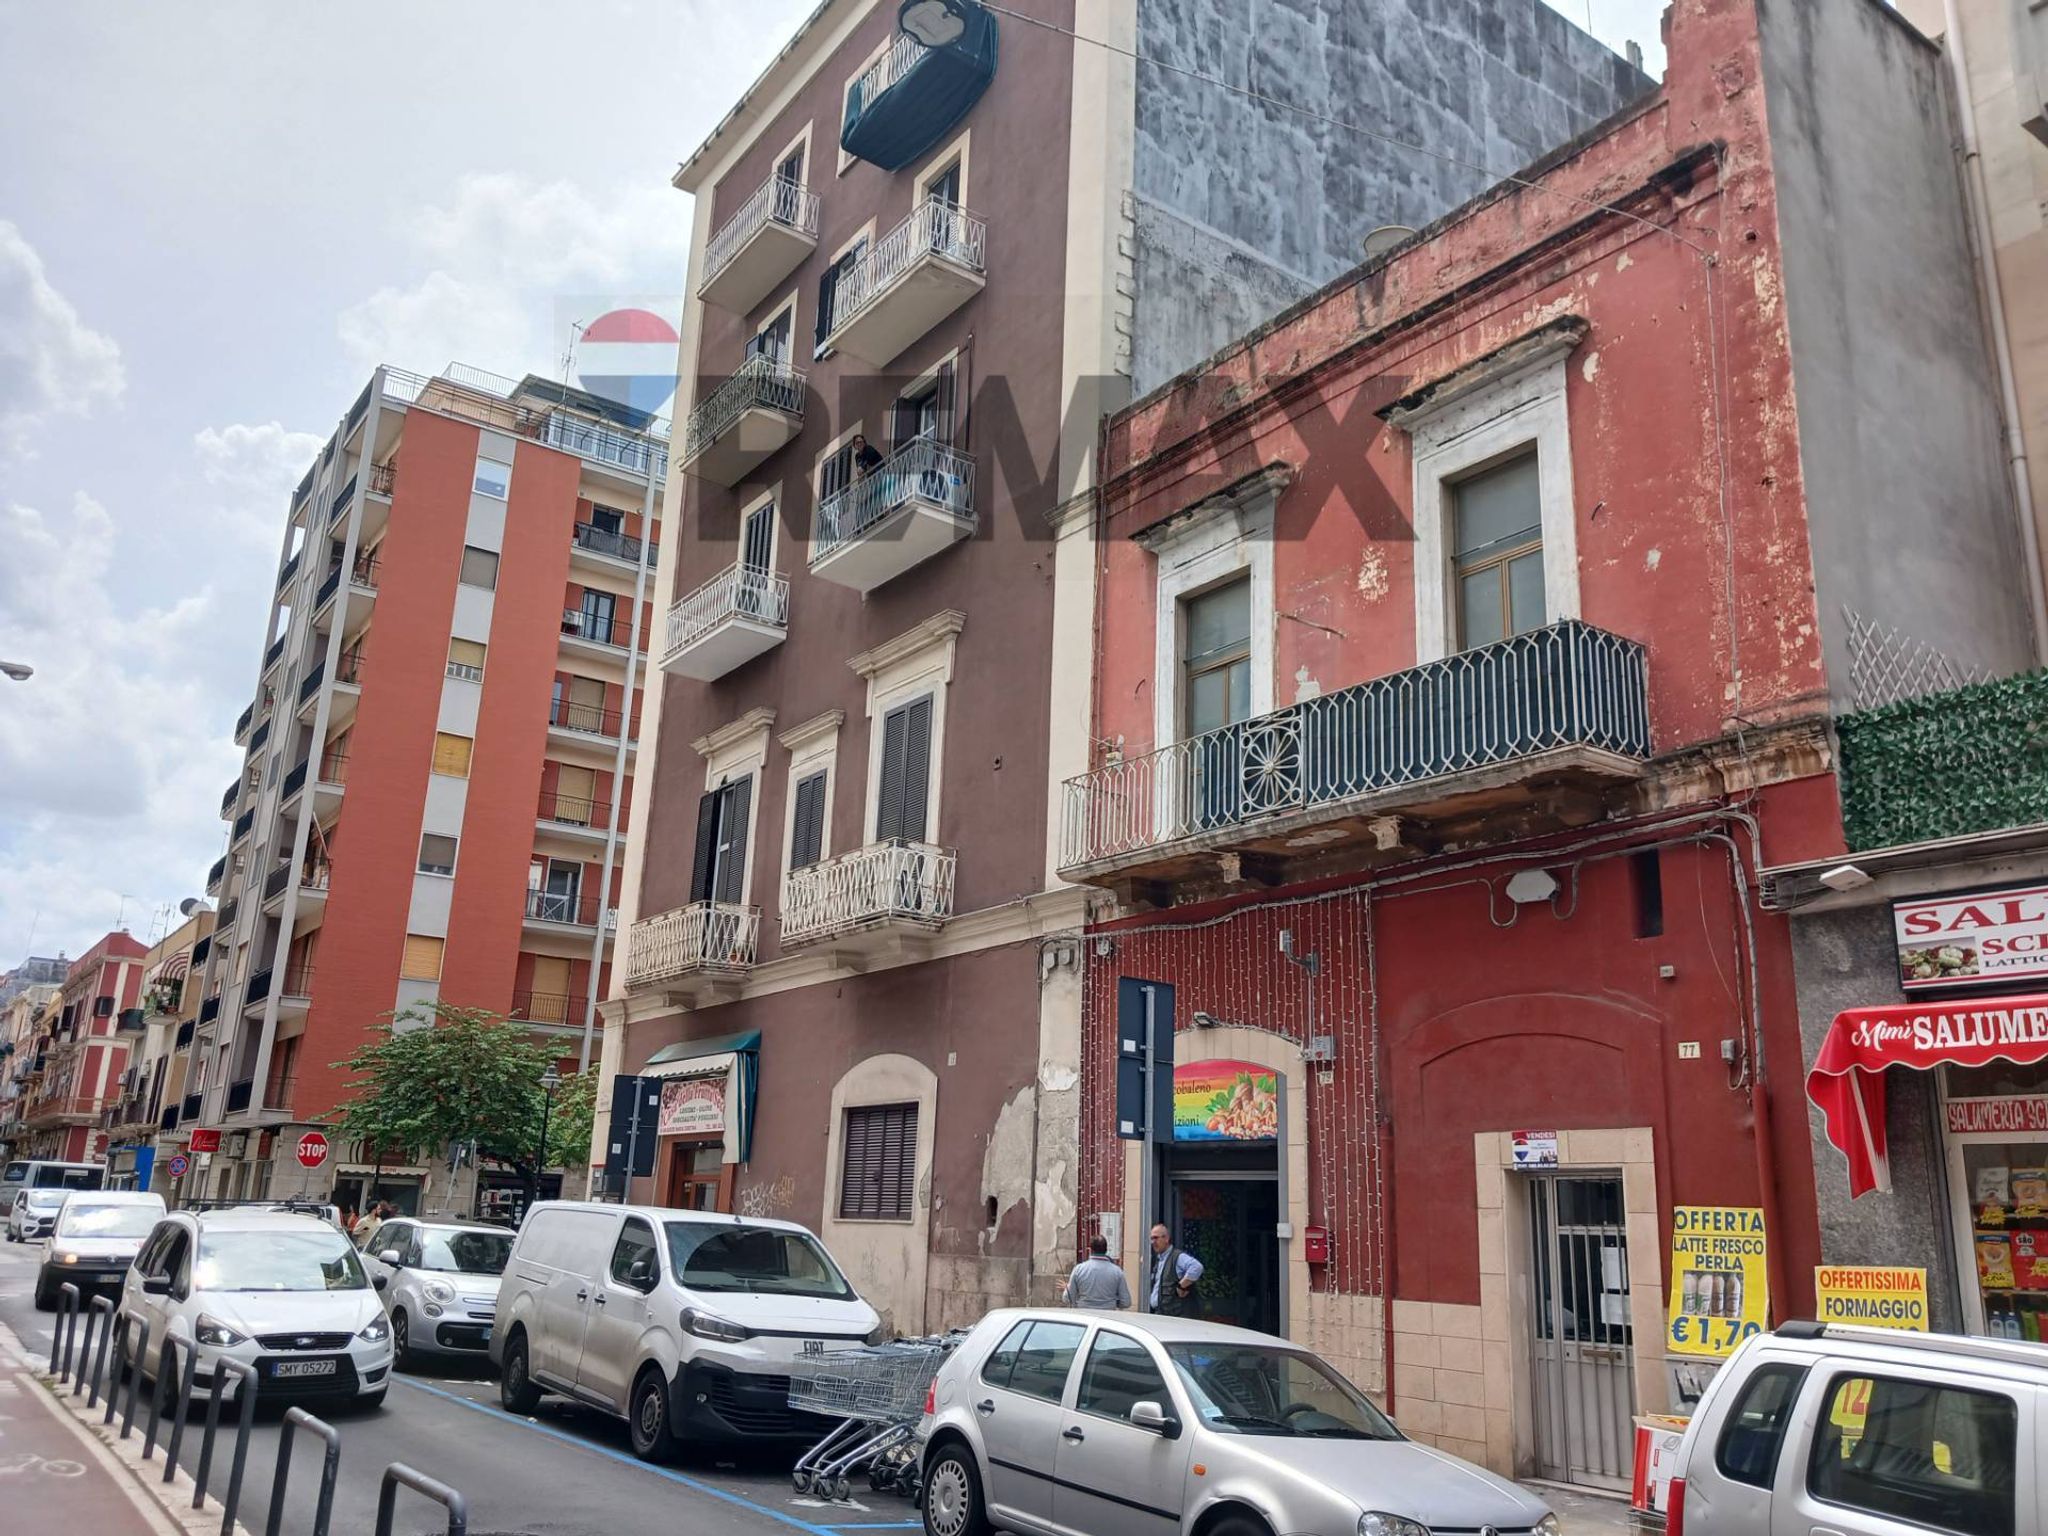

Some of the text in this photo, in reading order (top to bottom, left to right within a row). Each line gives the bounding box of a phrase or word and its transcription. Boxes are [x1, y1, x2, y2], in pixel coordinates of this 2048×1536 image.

[1904, 896, 2048, 936] SAL
[1913, 1006, 2048, 1050] SALUME
[1682, 1044, 1696, 1057] 77
[1949, 1101, 2024, 1131] SALUMERIA
[299, 1143, 327, 1157] STOP
[1674, 1210, 1764, 1232] OFFERTA
[1674, 1237, 1764, 1255] LATTE FRESCO
[1695, 1255, 1743, 1270] PERLA
[1820, 1270, 1922, 1291] OFFERTISSIMA
[1826, 1297, 1922, 1319] FORMAGGIO
[1671, 1316, 1690, 1342] €
[803, 1340, 824, 1354] FIAT
[279, 1361, 335, 1375] SMY 05272
